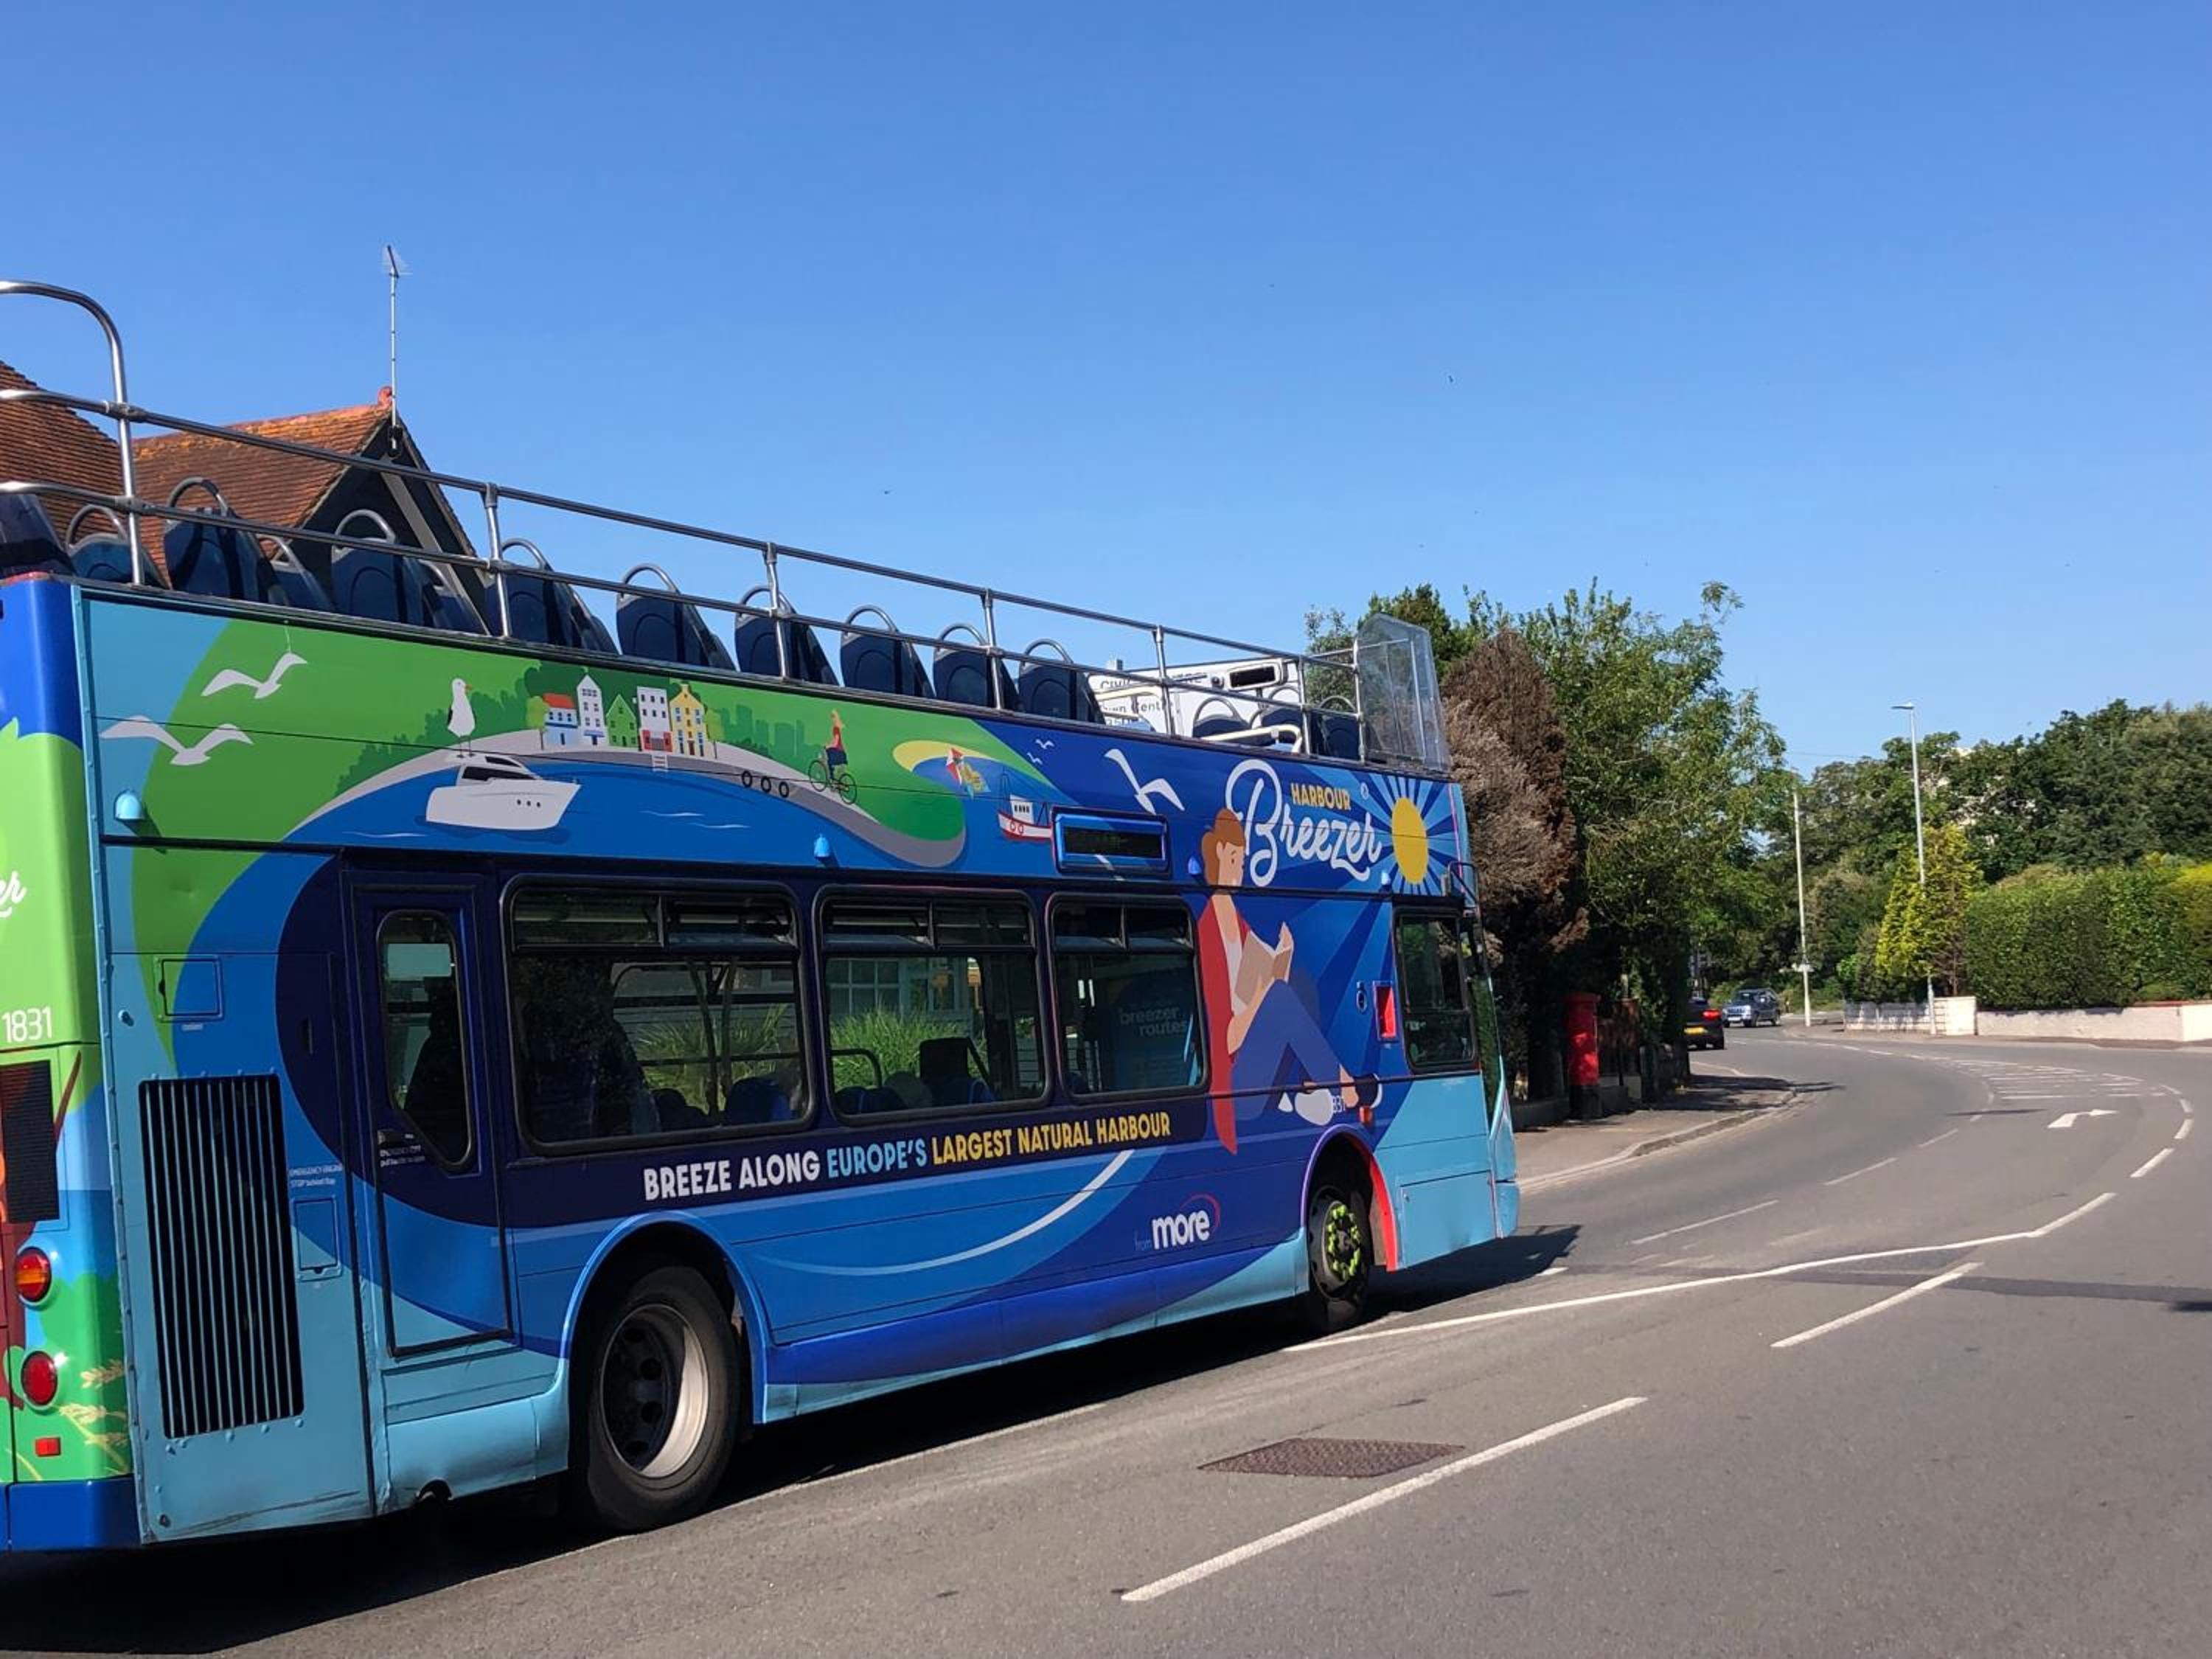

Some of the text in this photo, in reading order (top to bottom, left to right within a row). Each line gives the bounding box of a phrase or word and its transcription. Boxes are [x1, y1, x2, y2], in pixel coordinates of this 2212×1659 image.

[1290, 782, 1351, 810] HARBOUR
[1225, 759, 1382, 887] Breezer
[2, 1006, 52, 1043] 1831
[644, 1112, 1171, 1201] BREEZE ALONG EUROPE'S LARGEST NATURAL HARBOUR
[1152, 1210, 1210, 1250] more
